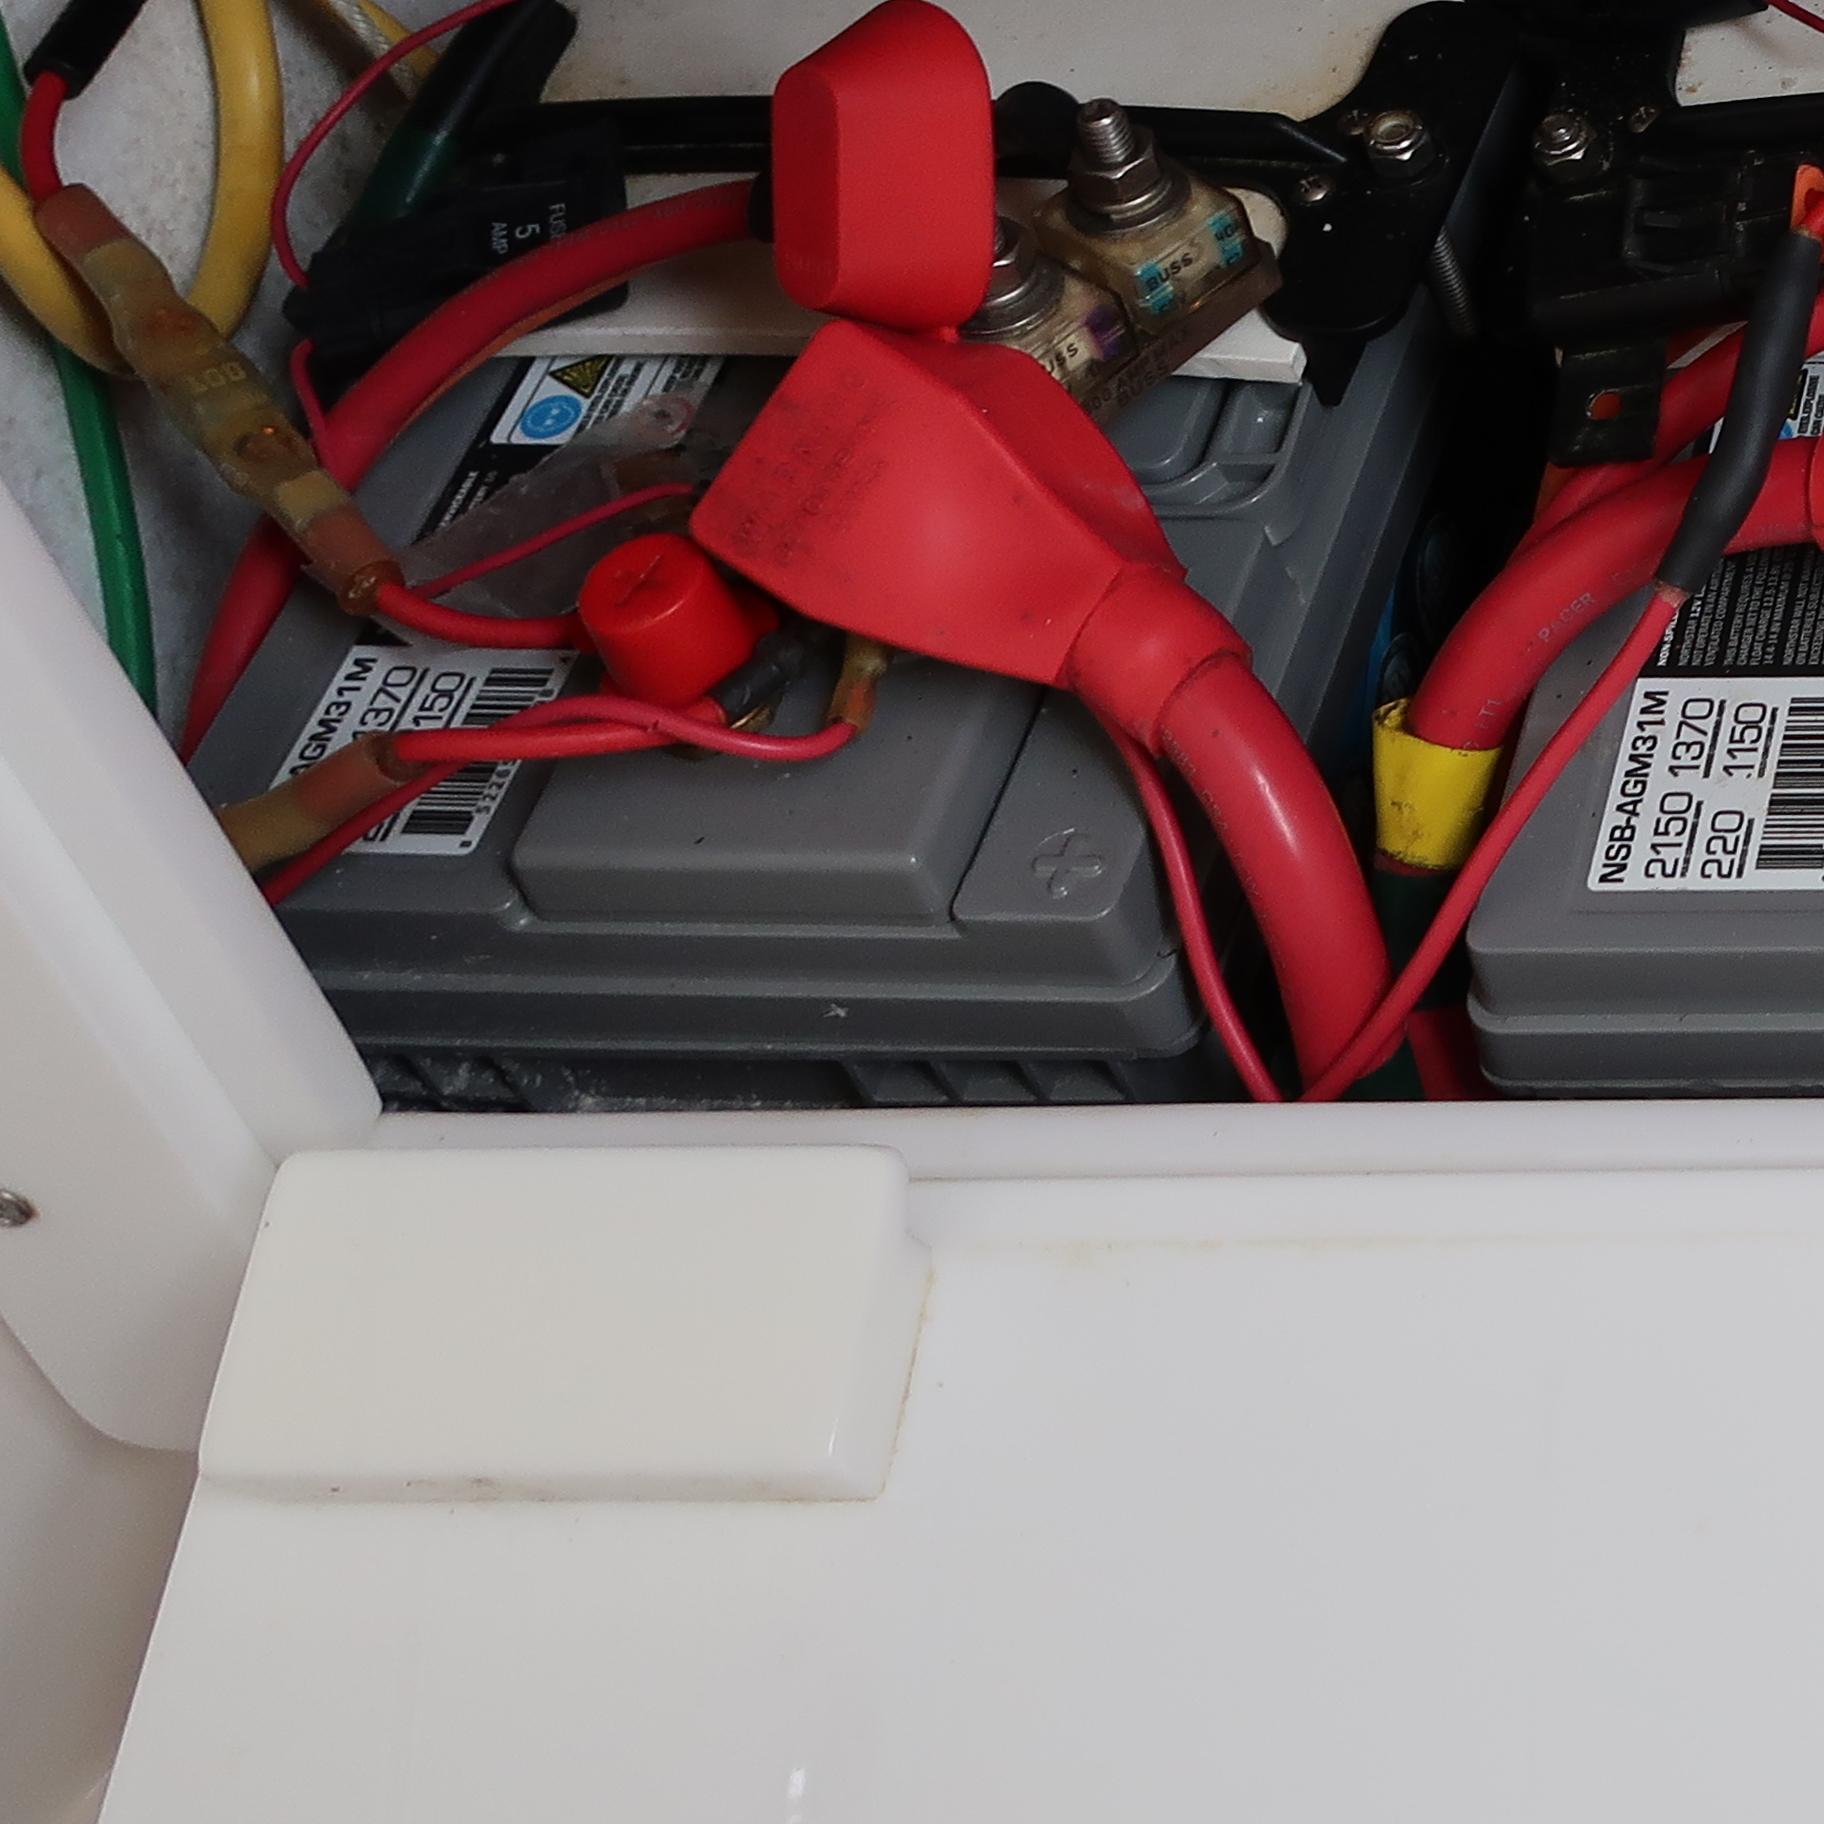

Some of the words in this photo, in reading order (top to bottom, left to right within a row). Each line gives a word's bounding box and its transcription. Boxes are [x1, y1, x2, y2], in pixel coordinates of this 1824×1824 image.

[490, 222, 510, 255] AMP
[514, 223, 541, 239] 5
[1145, 252, 1194, 291] BUSS
[412, 671, 466, 727] 150
[1599, 690, 1670, 884] NSB-AGM31M
[1643, 791, 1693, 879] 2150
[1668, 697, 1715, 777] 1370
[1700, 810, 1745, 880] 220
[1723, 702, 1768, 777] 1150
